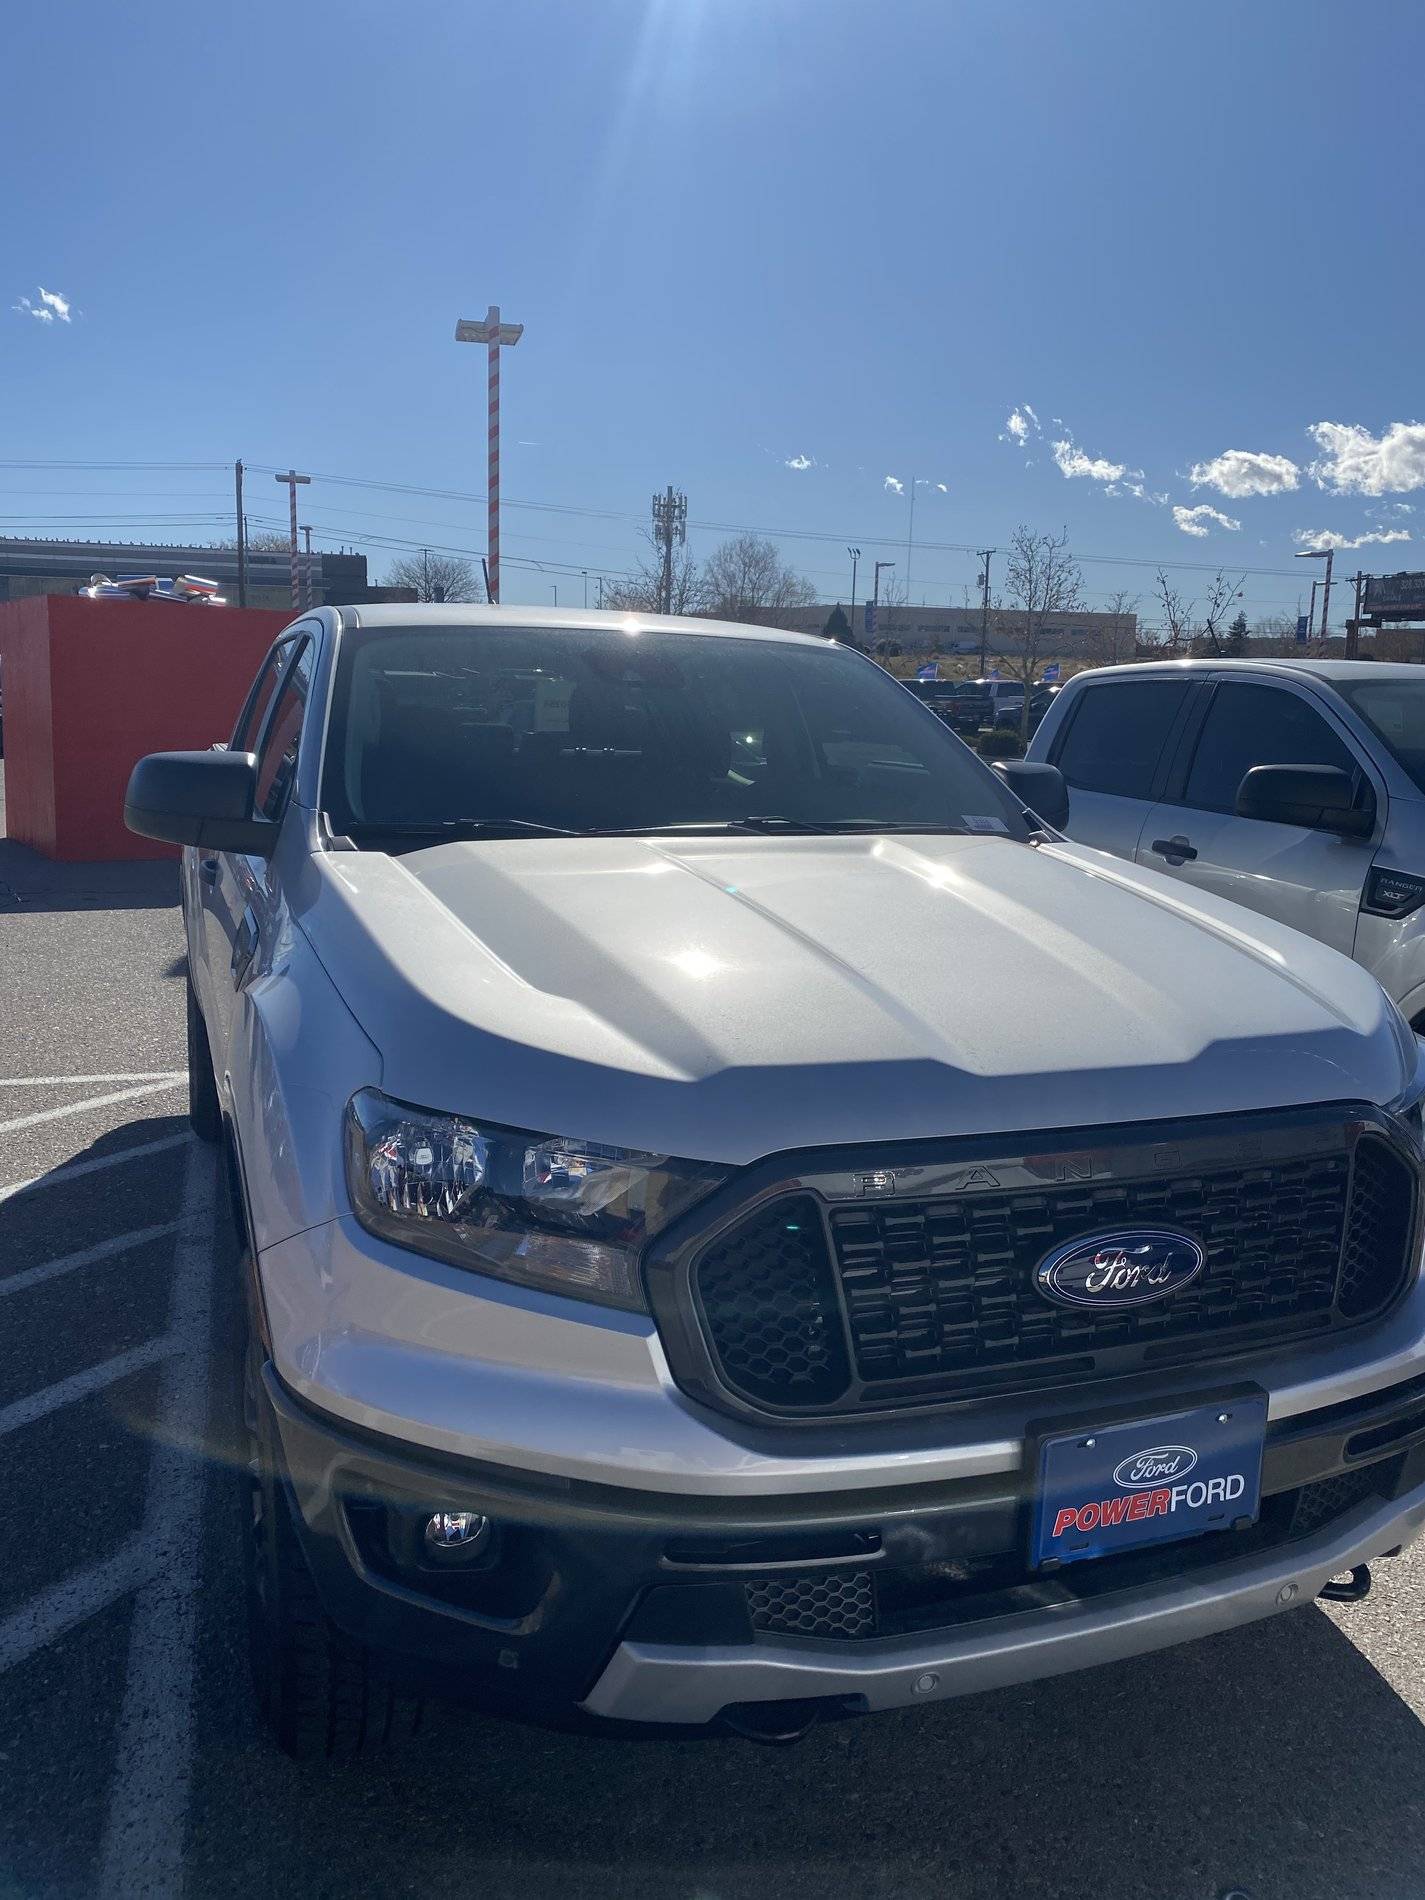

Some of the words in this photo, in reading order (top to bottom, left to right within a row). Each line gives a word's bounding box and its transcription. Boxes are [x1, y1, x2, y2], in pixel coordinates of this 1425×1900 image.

[1383, 890, 1405, 900] XLT
[853, 1135, 1330, 1198] RANG
[1085, 1243, 1172, 1292] Ford
[1130, 1452, 1181, 1481] Ford
[1052, 1474, 1245, 1537] POWERFORD
